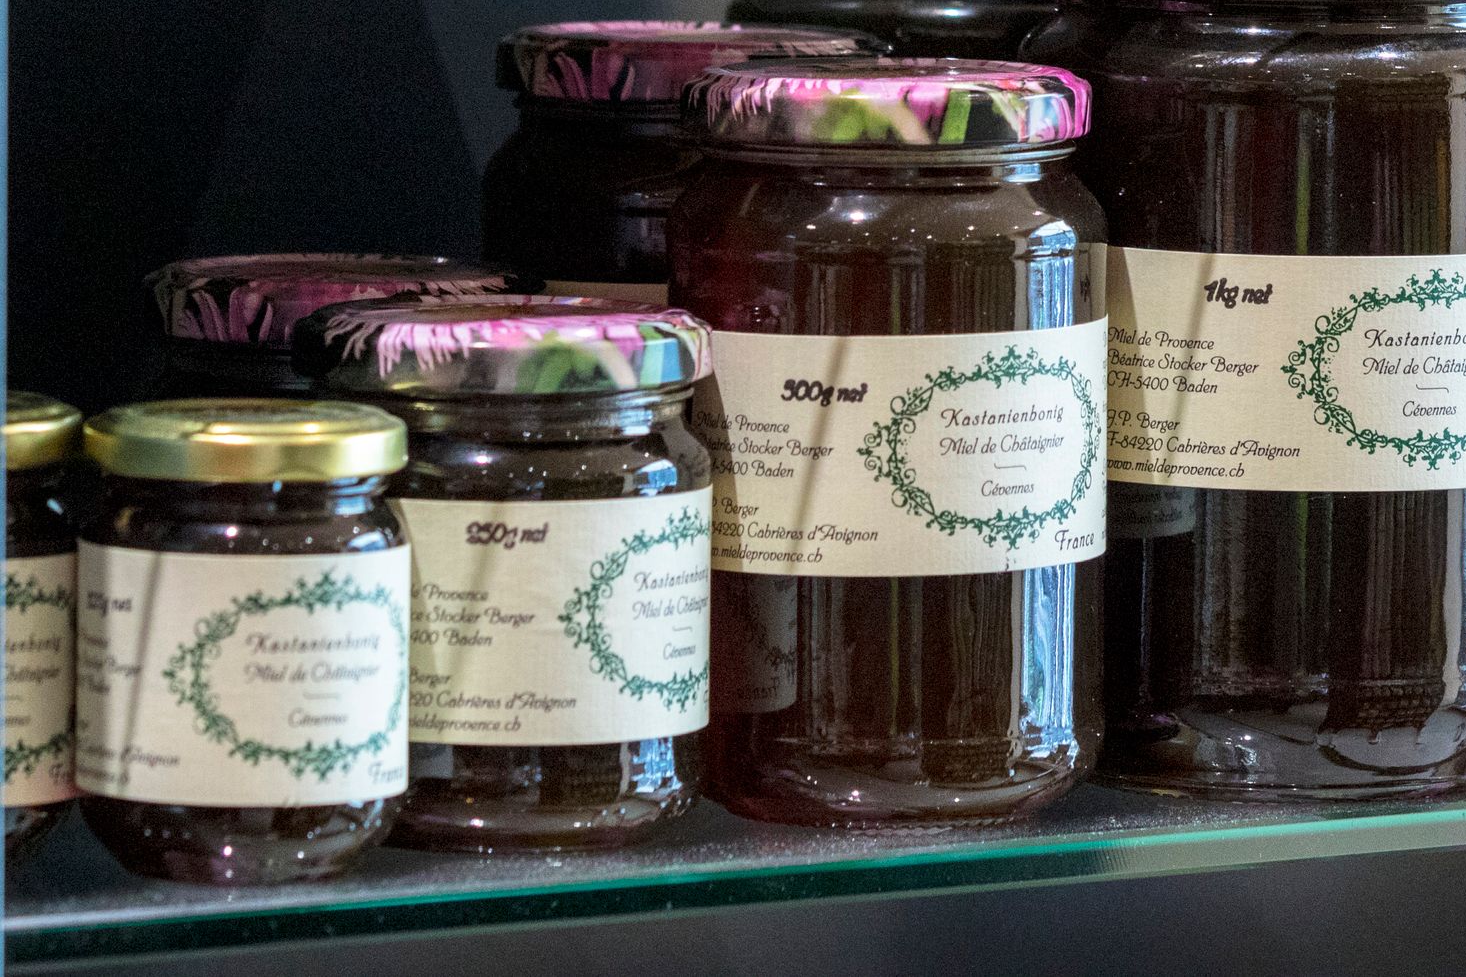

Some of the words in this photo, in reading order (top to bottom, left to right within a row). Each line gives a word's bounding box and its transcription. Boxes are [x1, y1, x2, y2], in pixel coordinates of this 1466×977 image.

[1203, 277, 1240, 310] 1kg
[1241, 283, 1274, 305] net
[1108, 326, 1136, 343] Miel
[1137, 330, 1152, 346] de
[1154, 330, 1215, 351] Provence
[1107, 348, 1155, 369] Béatrice
[1157, 352, 1208, 372] Stocker
[1210, 355, 1260, 377] Berger
[1362, 356, 1401, 376] Miel
[1402, 358, 1419, 375] de
[780, 378, 835, 408] 500g
[836, 382, 869, 403] net
[1107, 370, 1169, 391] CH-5400
[1172, 375, 1219, 394] Baden
[940, 404, 1064, 429] Kastanienhonig
[1402, 400, 1458, 419] Cévennes
[734, 414, 791, 434] Provence
[1136, 411, 1181, 433] Berger
[738, 436, 784, 456] Stocker
[786, 438, 834, 461] Berger
[939, 436, 978, 456] Miel
[980, 438, 997, 454] de
[1000, 433, 1065, 454] Châtaignier
[1165, 435, 1226, 456] Cabrières
[1229, 438, 1301, 461] d'Avignon
[751, 459, 795, 478] Baden
[981, 479, 1035, 498] Cévennes
[721, 496, 760, 520] Berger
[519, 522, 550, 545] net
[746, 522, 804, 542] Cabrières
[807, 524, 879, 545] d'Avignon
[1054, 528, 1095, 552] France
[423, 583, 489, 603] Provence
[426, 607, 481, 625] Stocker
[483, 608, 536, 630] Berger
[631, 599, 662, 621] Miel
[442, 629, 493, 648] Baden
[435, 692, 502, 710] Cabrières
[504, 692, 577, 712] d'Avignon
